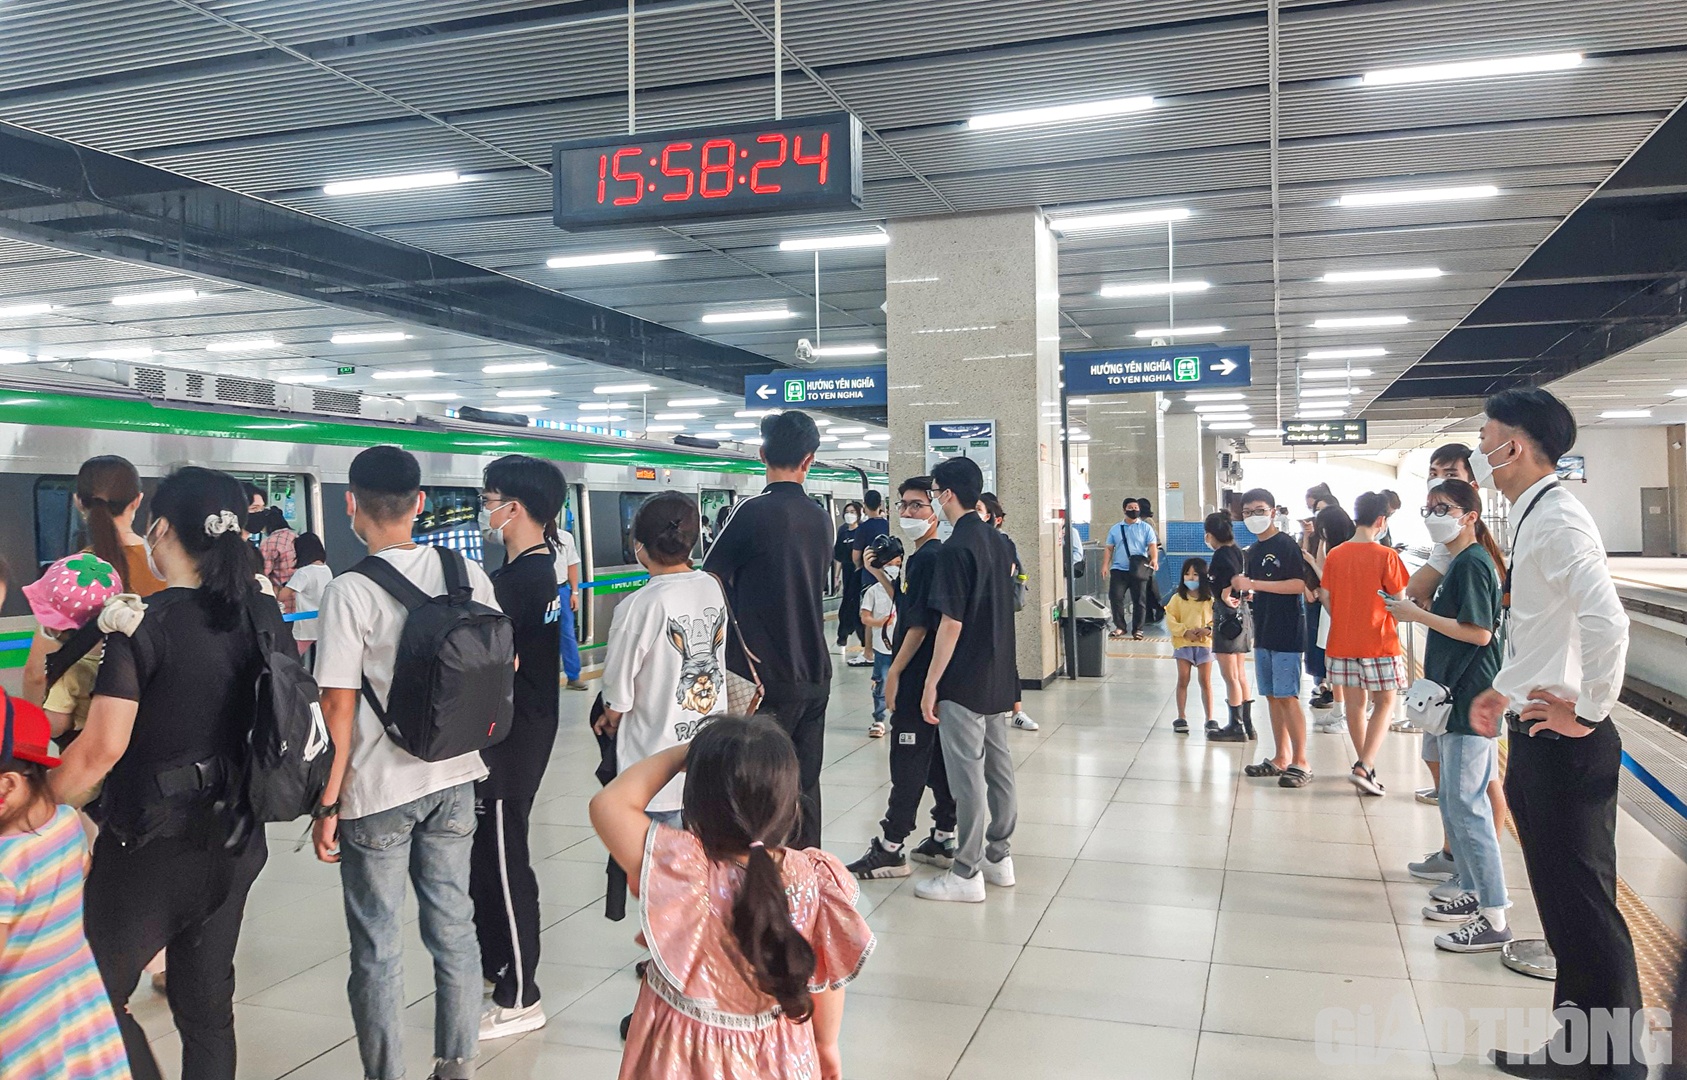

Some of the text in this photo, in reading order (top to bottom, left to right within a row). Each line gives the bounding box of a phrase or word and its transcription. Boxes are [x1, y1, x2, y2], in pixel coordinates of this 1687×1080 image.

[597, 133, 829, 206] 15:58:24
[1090, 358, 1172, 375] HƯỚNG YÊN NGHĨA
[806, 376, 875, 390] HƯỚNG YÊN NGHĨA
[1107, 373, 1172, 385] TO YEN NGHIA
[806, 390, 864, 400] TO YEN NGHIA
